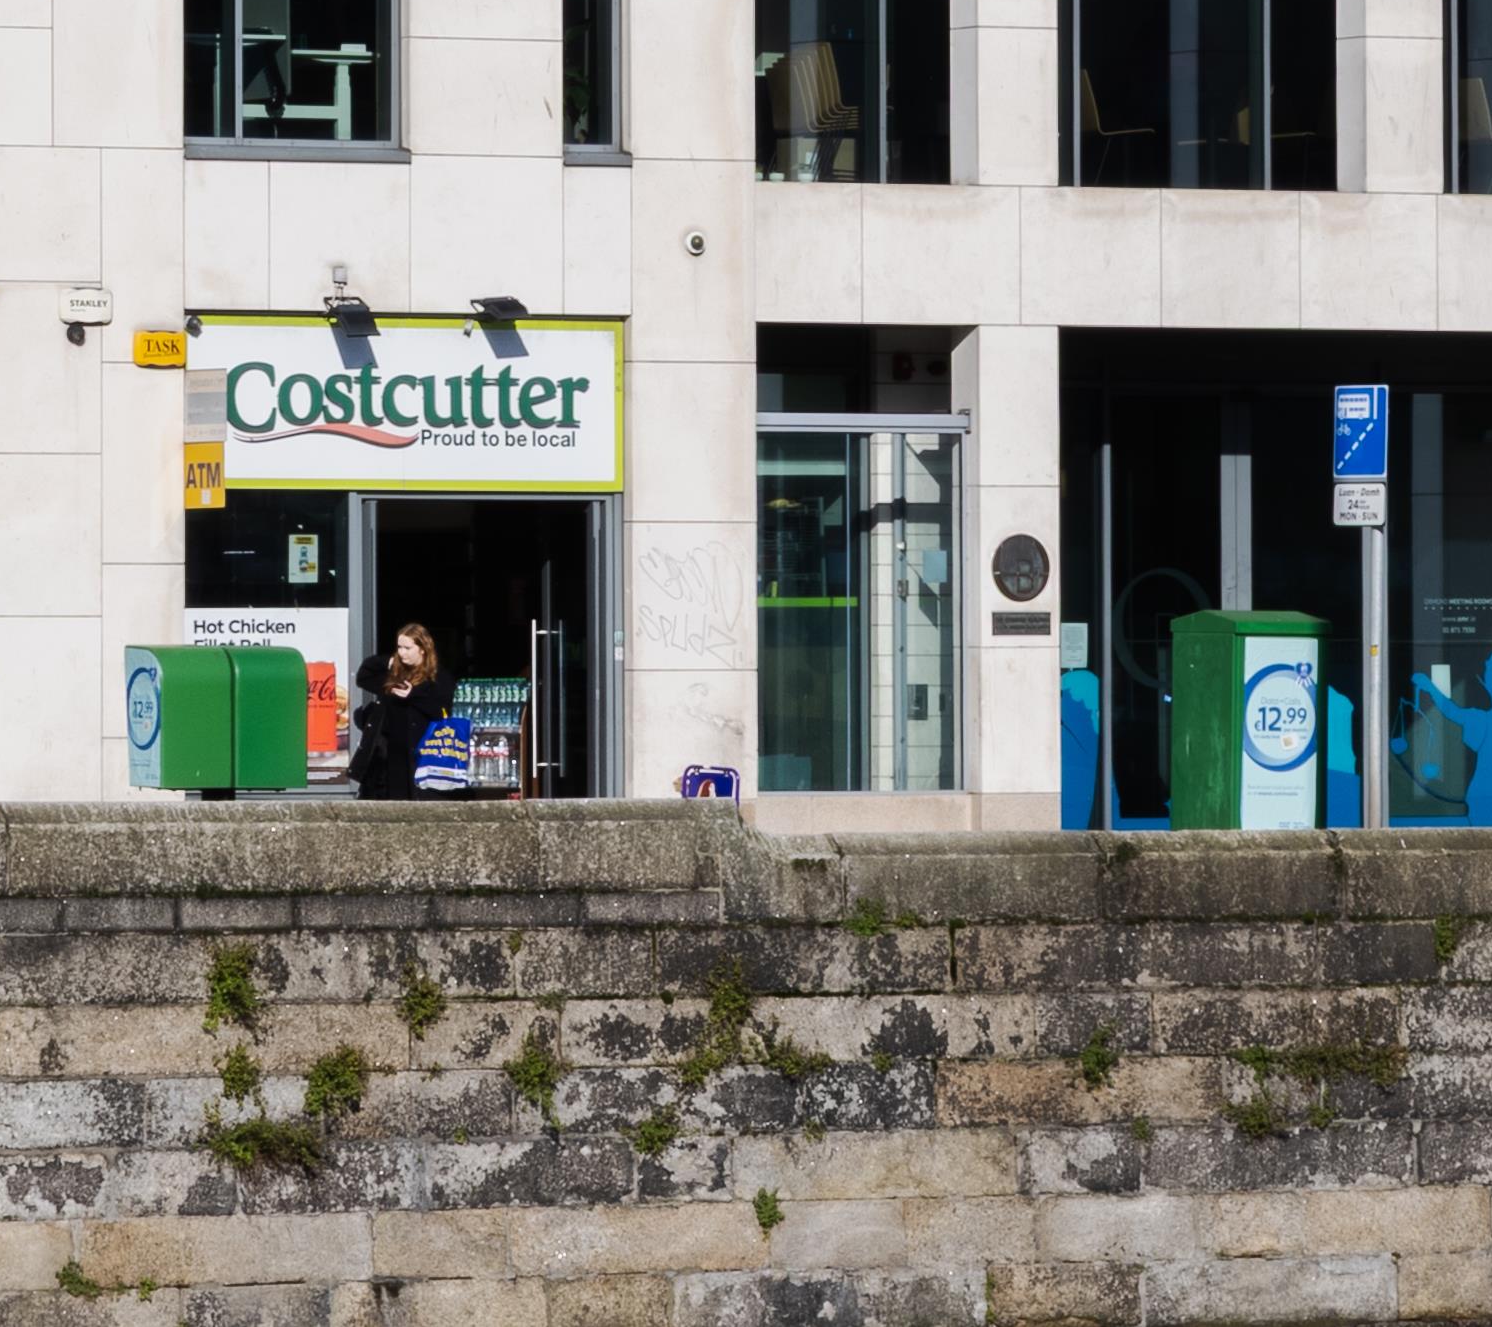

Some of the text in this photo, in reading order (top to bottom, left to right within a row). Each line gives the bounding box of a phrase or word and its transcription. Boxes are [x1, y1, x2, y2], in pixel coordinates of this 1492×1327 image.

[69, 299, 108, 309] STANLEY
[144, 339, 180, 354] TASK
[227, 361, 589, 434] Costcutter
[421, 429, 576, 447] Proud to be local
[186, 462, 222, 489] ATM
[193, 618, 296, 634] Hot Chicken
